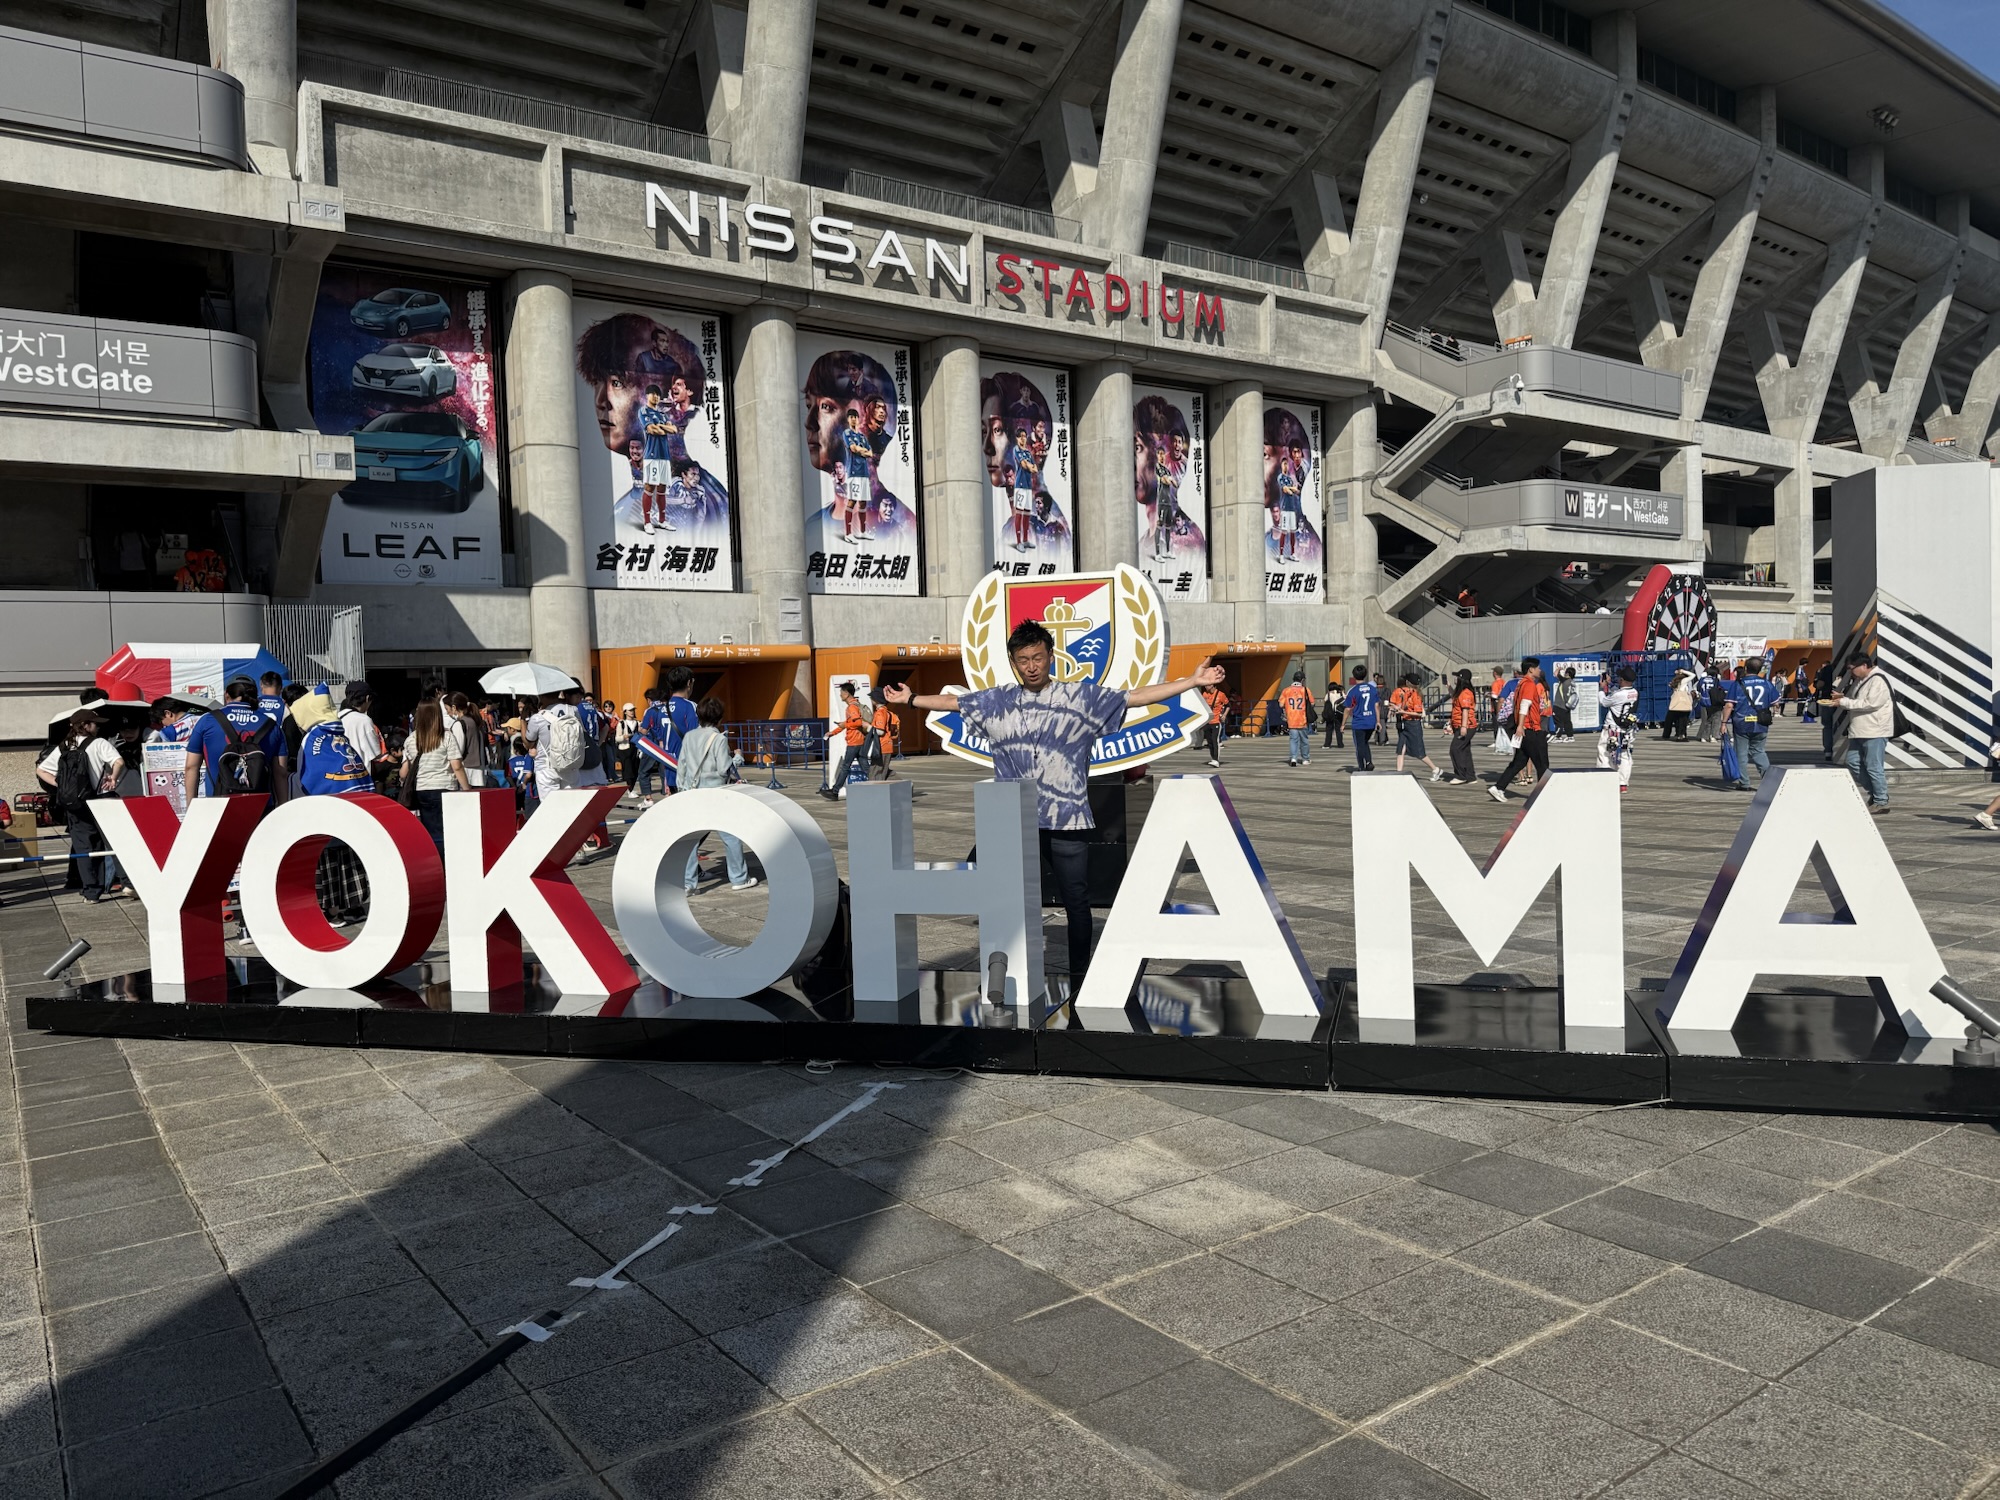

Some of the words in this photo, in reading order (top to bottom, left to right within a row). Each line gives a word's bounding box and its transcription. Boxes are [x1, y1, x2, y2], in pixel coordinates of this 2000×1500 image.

[645, 182, 968, 287] NISSAN
[996, 254, 1226, 333] STADIUM
[0, 329, 66, 359] 大门
[98, 339, 150, 366] 서문
[466, 290, 490, 432] 継承する。進化する。
[701, 320, 721, 449] 継承する。進化する。
[894, 350, 911, 467] 継承する。進化する。
[652, 467, 658, 477] 9
[851, 483, 860, 493] 22
[1566, 493, 1579, 513] W
[1583, 491, 1633, 521] 西ゲート
[391, 521, 434, 530] NISSAN
[342, 532, 481, 560] LEAF
[596, 542, 656, 572] 谷村
[660, 545, 719, 574] 海那
[807, 551, 849, 579] 角田
[851, 553, 911, 580] 涼太朗
[675, 648, 686, 658] W
[690, 646, 734, 658] 西ゲート
[898, 647, 906, 656] W
[909, 646, 945, 657] 西ゲート
[1288, 697, 1304, 710] 92
[1362, 693, 1371, 711] 7
[1745, 685, 1765, 706] 12
[661, 717, 672, 751] 7
[514, 766, 524, 780] 7
[88, 765, 1972, 1040] YOKOHAMA
